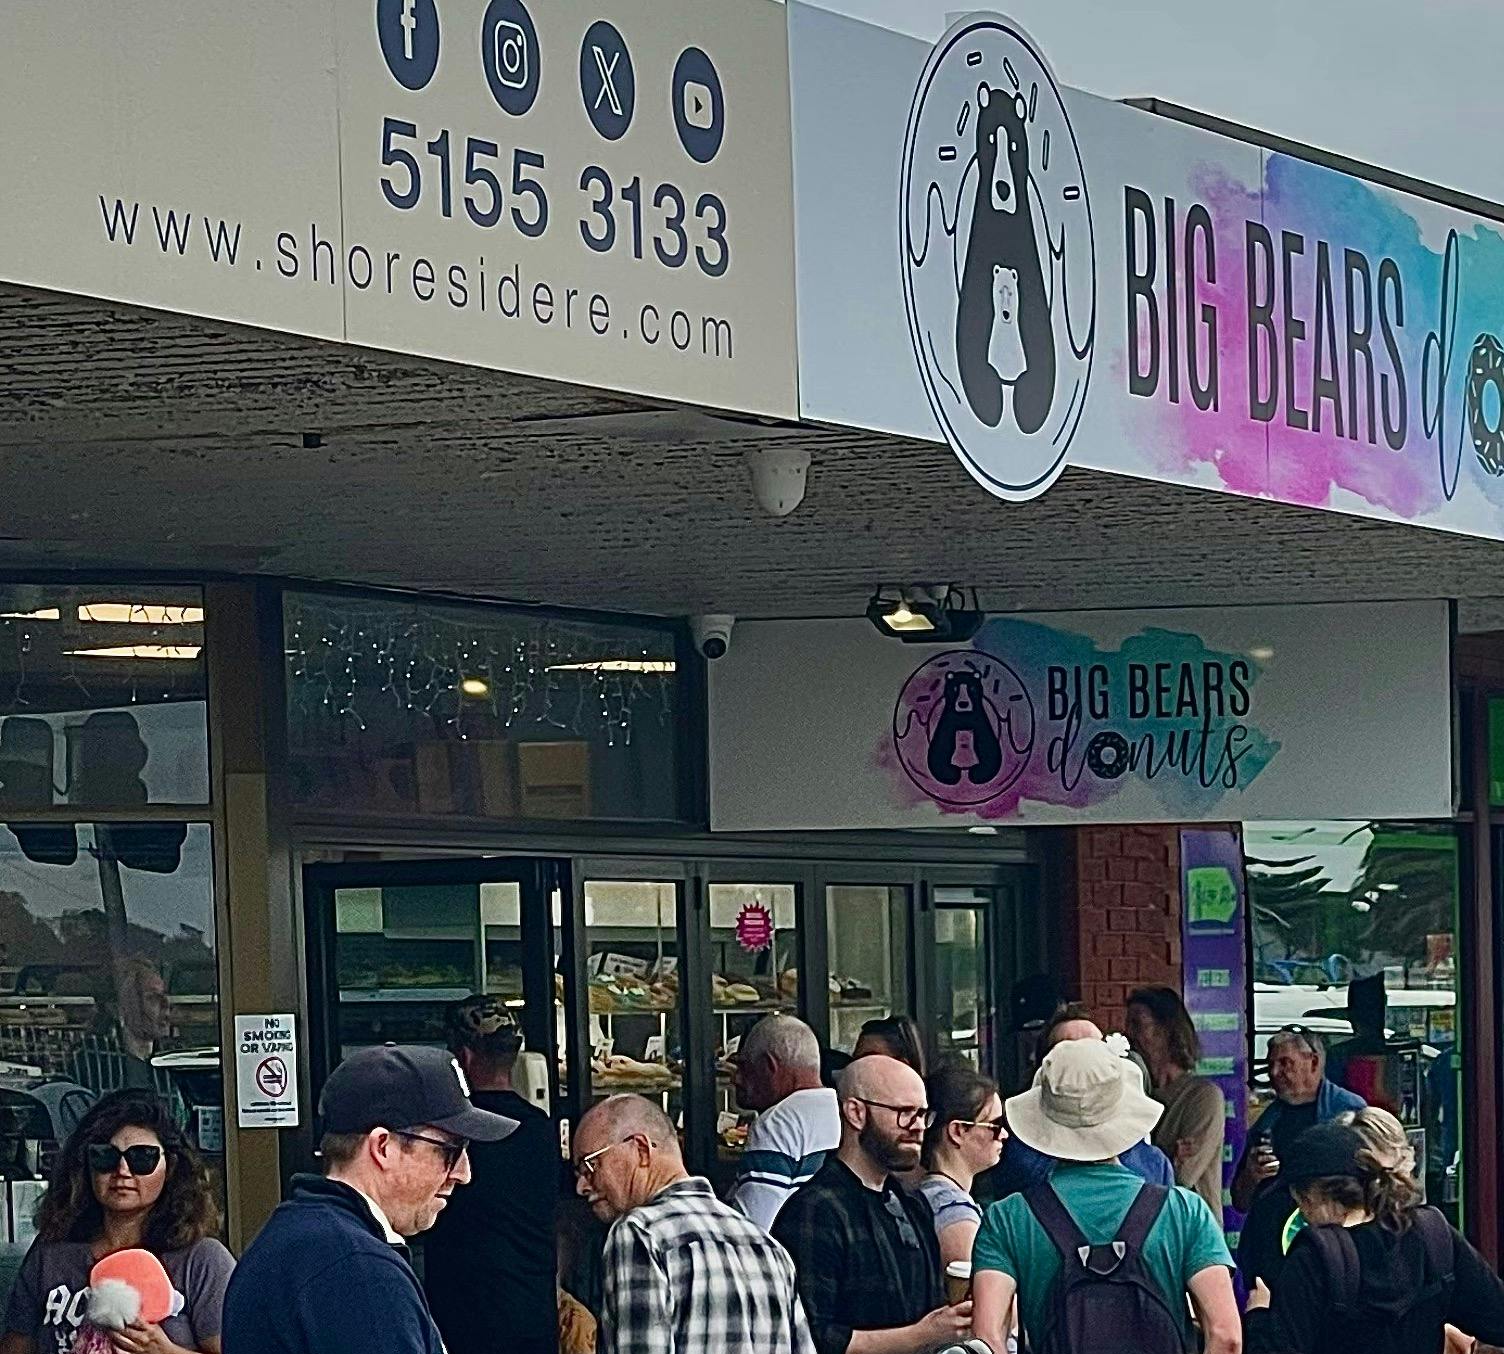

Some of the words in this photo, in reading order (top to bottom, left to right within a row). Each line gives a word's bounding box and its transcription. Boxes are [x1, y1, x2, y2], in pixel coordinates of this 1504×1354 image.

[380, 117, 549, 239] 5155
[580, 166, 730, 278] 3133
[99, 194, 734, 359] www.shoresidere.com
[1125, 185, 1219, 413] BIG
[1246, 220, 1407, 450] BEARS
[1047, 665, 1110, 721] BIG
[1129, 661, 1251, 719] BEARS
[1047, 704, 1255, 791] donuts
[240, 1043, 259, 1053] OR
[43, 1284, 91, 1327] AC
